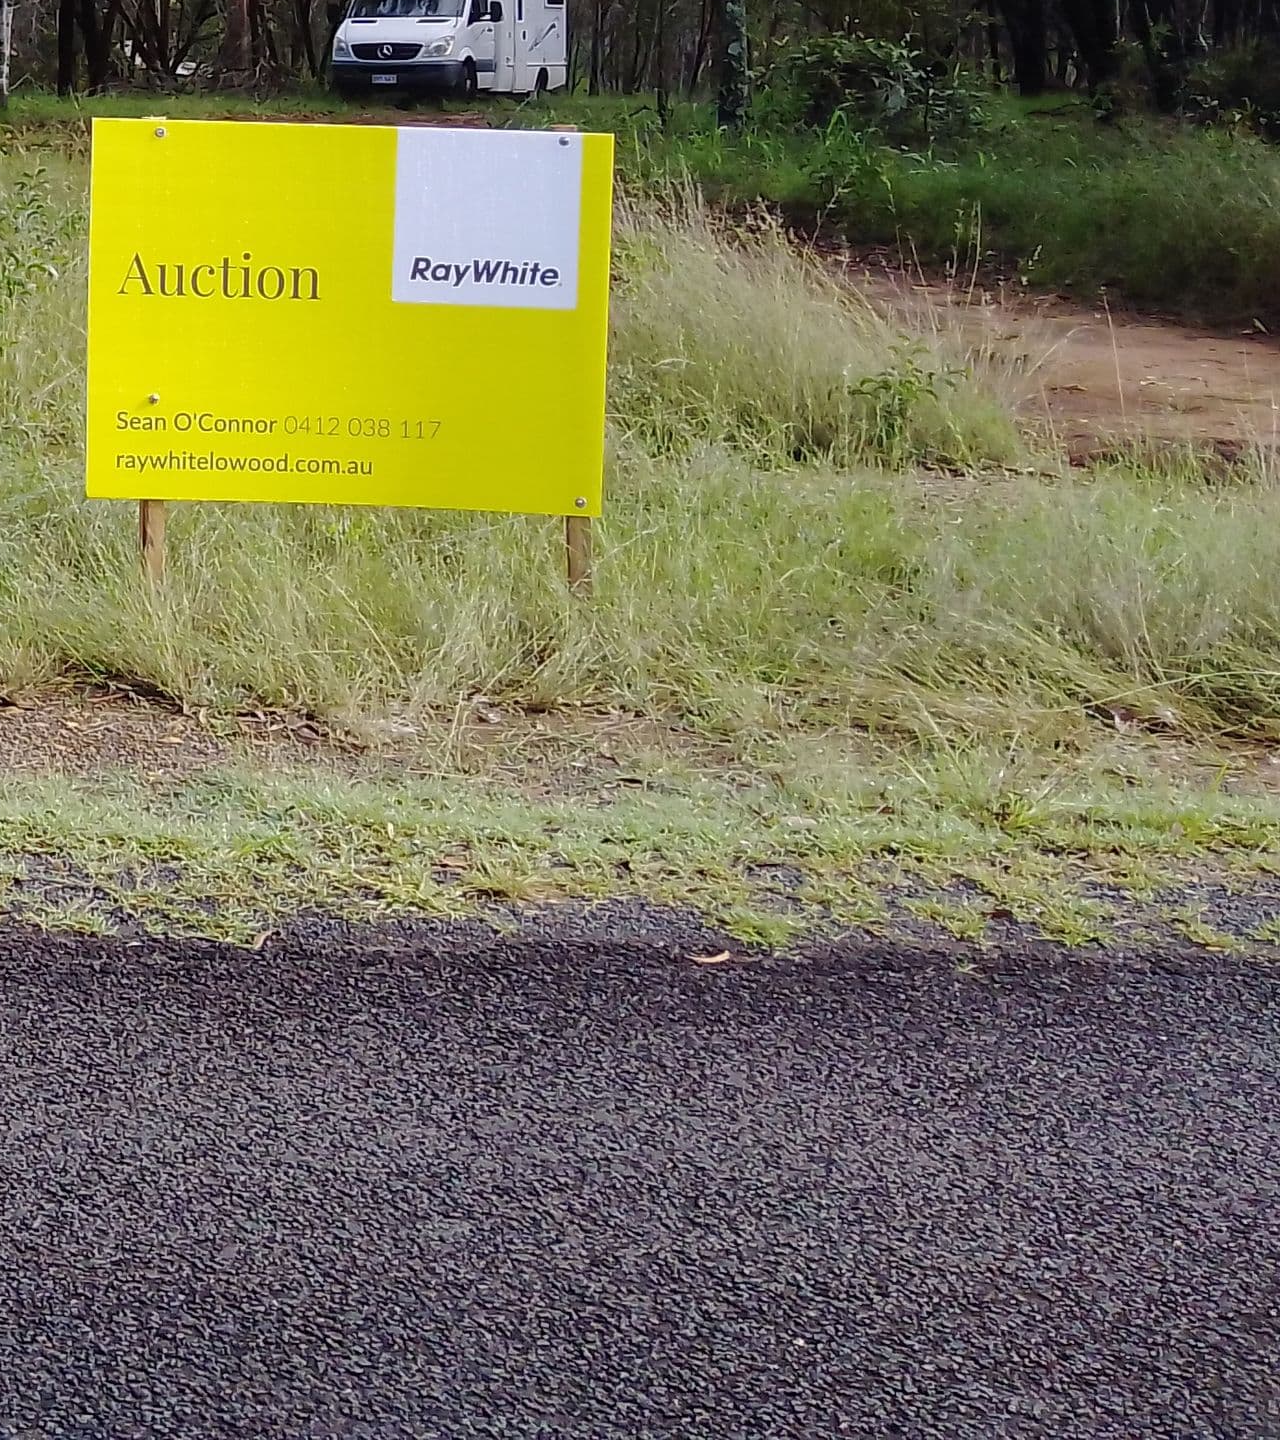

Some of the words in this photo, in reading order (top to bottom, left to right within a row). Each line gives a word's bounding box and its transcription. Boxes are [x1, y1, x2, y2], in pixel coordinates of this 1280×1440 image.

[117, 252, 320, 300] Auction
[410, 257, 559, 287] RayWhite
[116, 412, 167, 431] Sean
[174, 412, 277, 434] O'Connor
[284, 415, 340, 436] 0412
[348, 418, 390, 438] 038
[401, 419, 442, 440] 117
[116, 450, 373, 476] raywhitelowood.com.au
